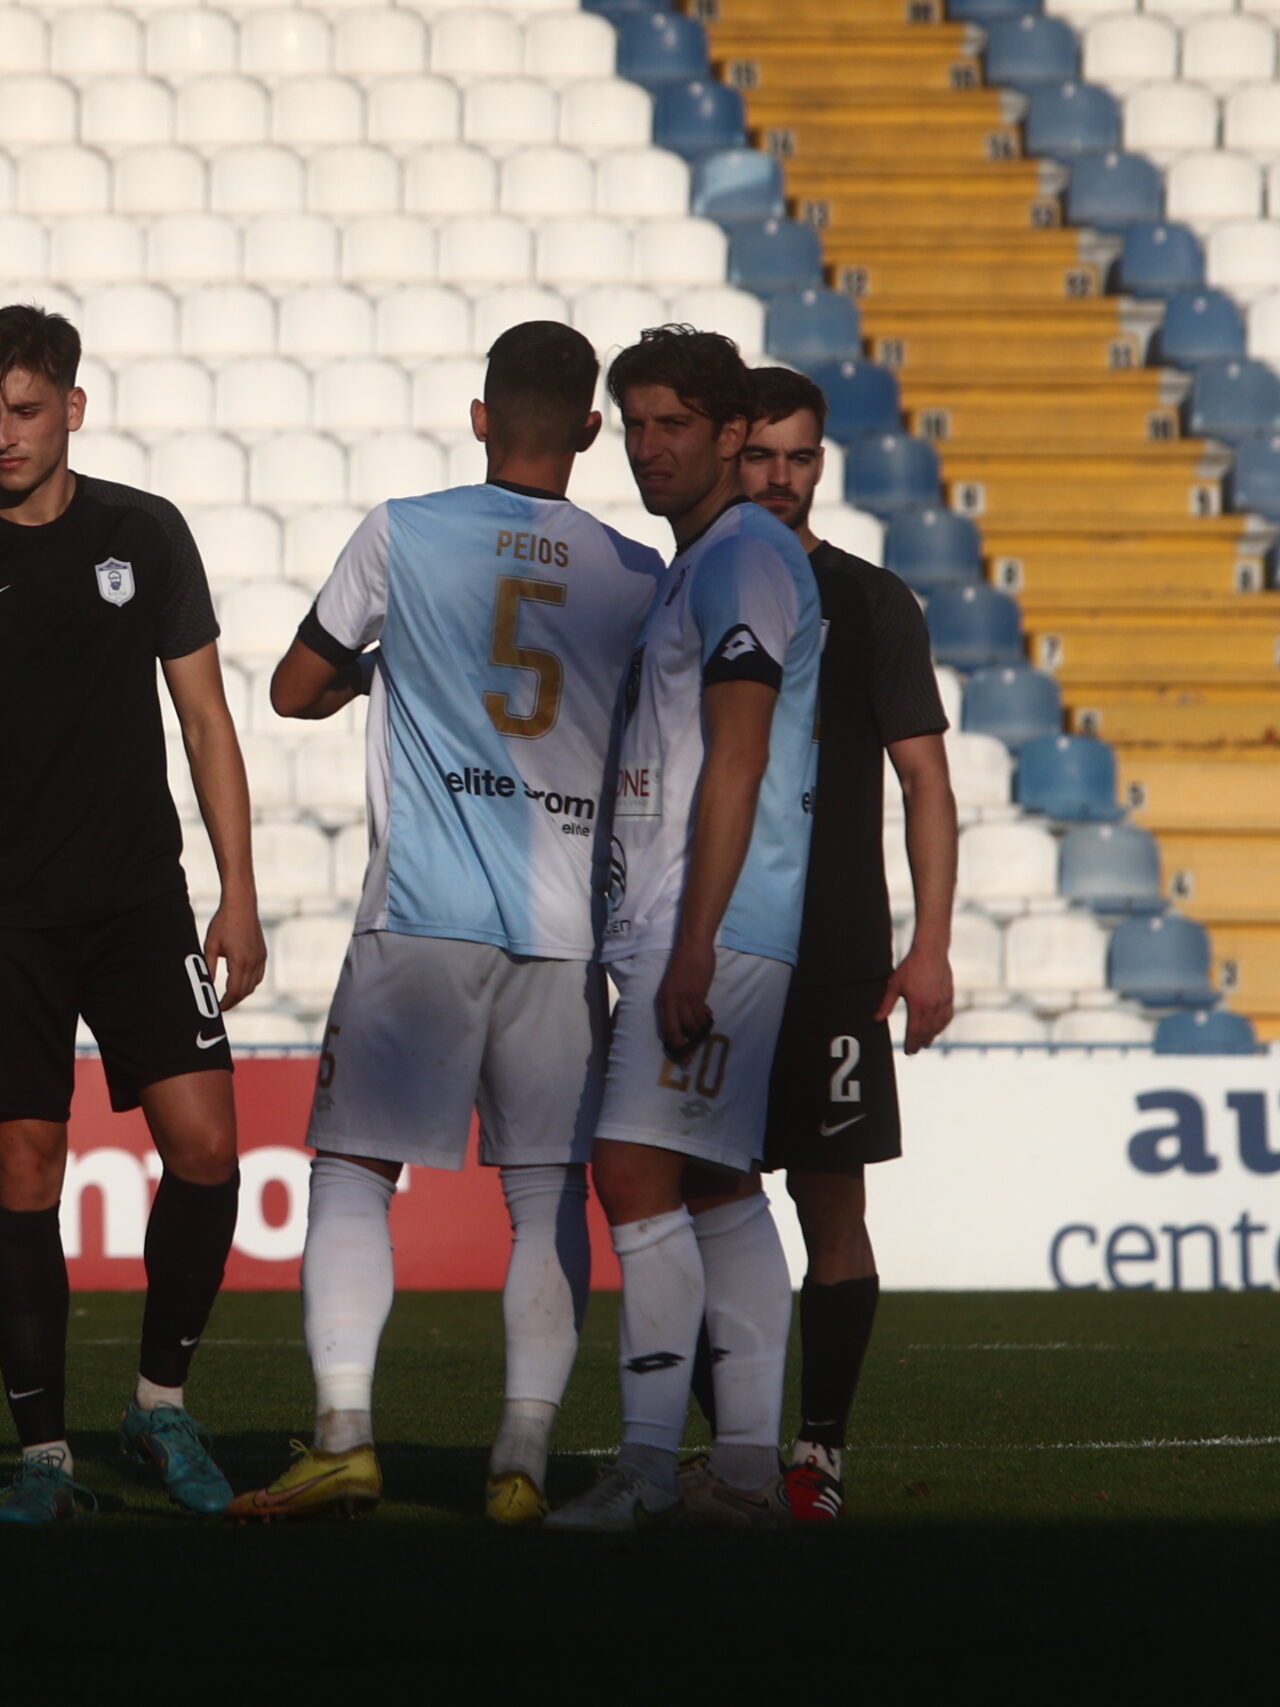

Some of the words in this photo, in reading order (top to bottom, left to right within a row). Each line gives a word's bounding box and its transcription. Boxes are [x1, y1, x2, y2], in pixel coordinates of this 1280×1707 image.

[497, 529, 570, 569] PEIOS
[483, 573, 567, 741] 5
[445, 767, 516, 798] elite
[185, 954, 219, 1018] 6
[830, 1035, 861, 1102] 2
[1049, 1211, 1280, 1290] cent
